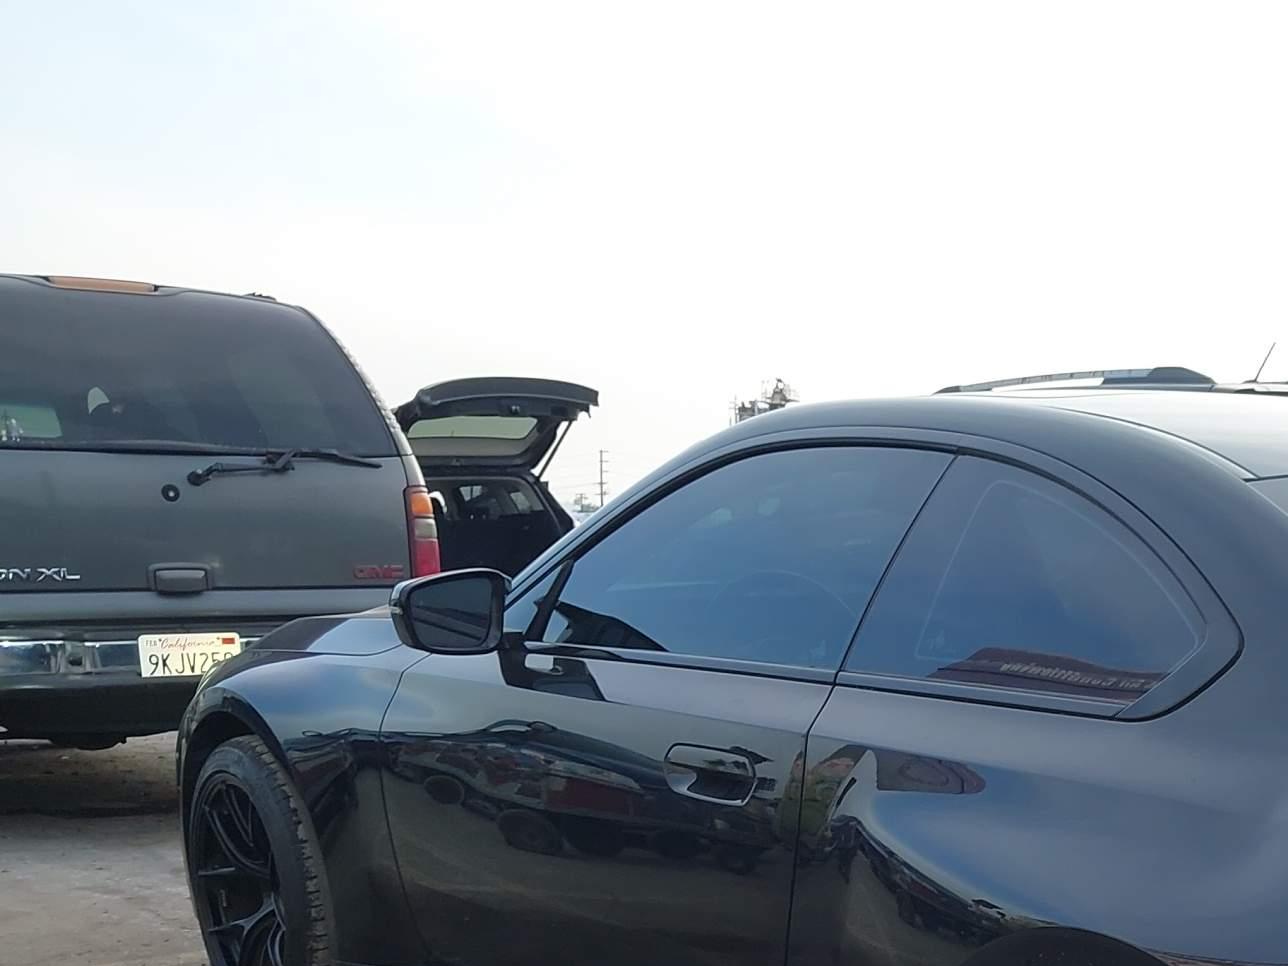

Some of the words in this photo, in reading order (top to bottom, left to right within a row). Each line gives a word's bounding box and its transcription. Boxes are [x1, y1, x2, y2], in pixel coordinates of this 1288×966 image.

[36, 567, 81, 582] XL
[160, 637, 215, 651] California
[148, 651, 234, 676] 9KJV25
